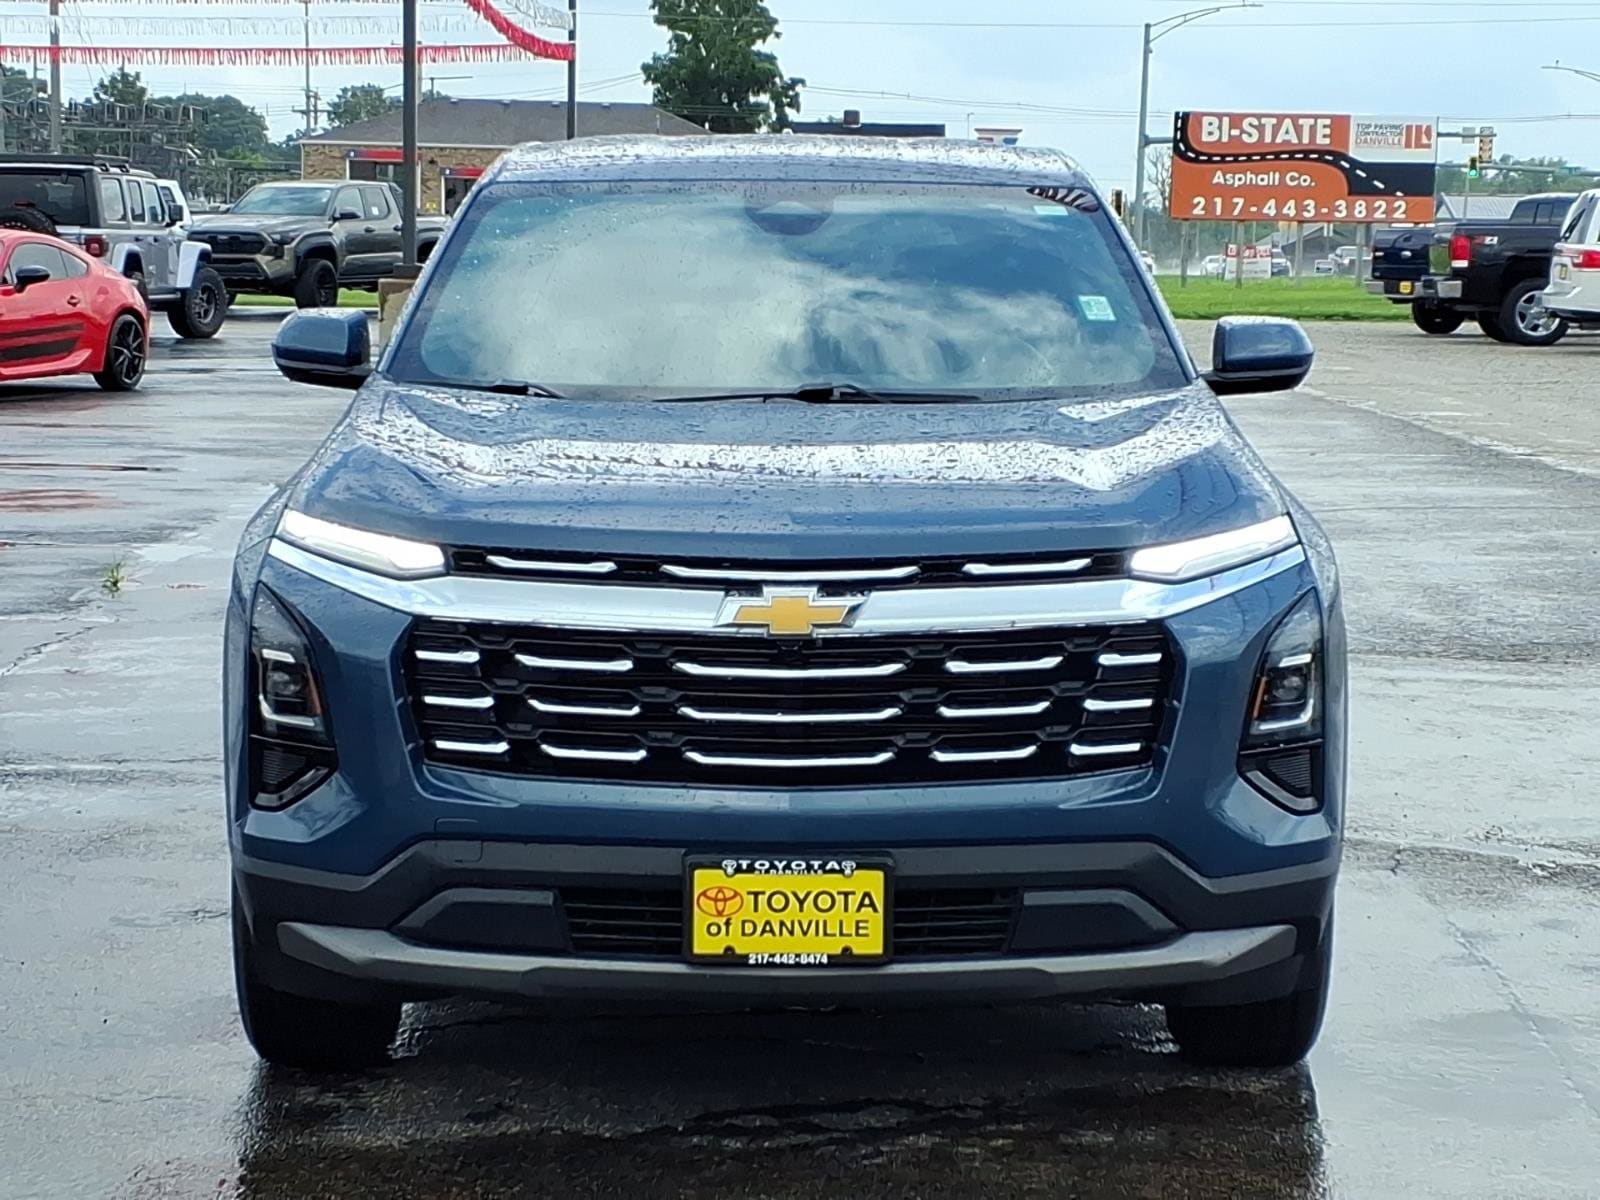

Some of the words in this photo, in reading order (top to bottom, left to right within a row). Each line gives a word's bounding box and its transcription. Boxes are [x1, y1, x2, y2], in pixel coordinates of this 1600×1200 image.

[1201, 115, 1332, 145] BI-STATE
[1212, 169, 1280, 188] Asphalt
[1285, 171, 1316, 187] Co.
[738, 860, 841, 871] TOYOTA
[746, 890, 879, 914] TOYOTA
[705, 917, 732, 938] of
[741, 919, 870, 938] DANVILLE
